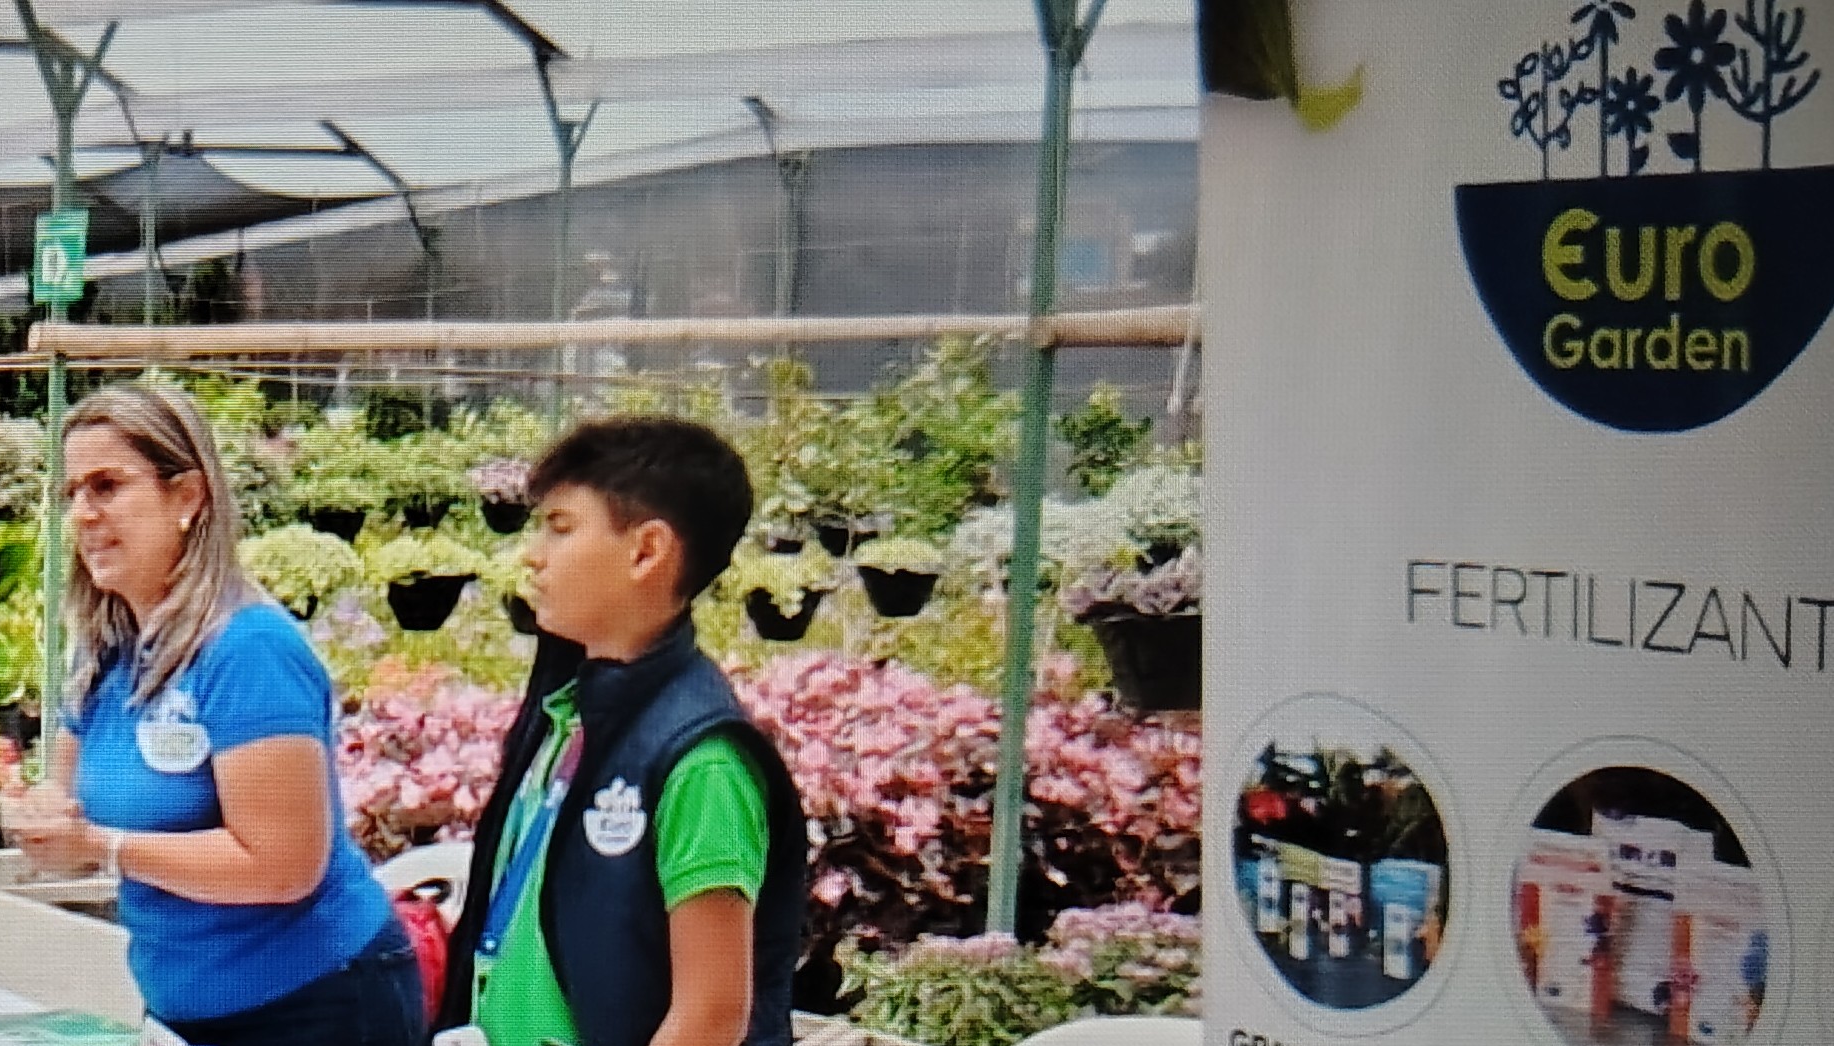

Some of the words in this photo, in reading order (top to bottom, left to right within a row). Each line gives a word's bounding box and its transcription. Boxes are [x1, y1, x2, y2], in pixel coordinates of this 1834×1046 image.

[1541, 207, 1756, 301] Euro
[1542, 312, 1751, 371] Garden
[1406, 558, 1834, 672] FERTILIZANT
